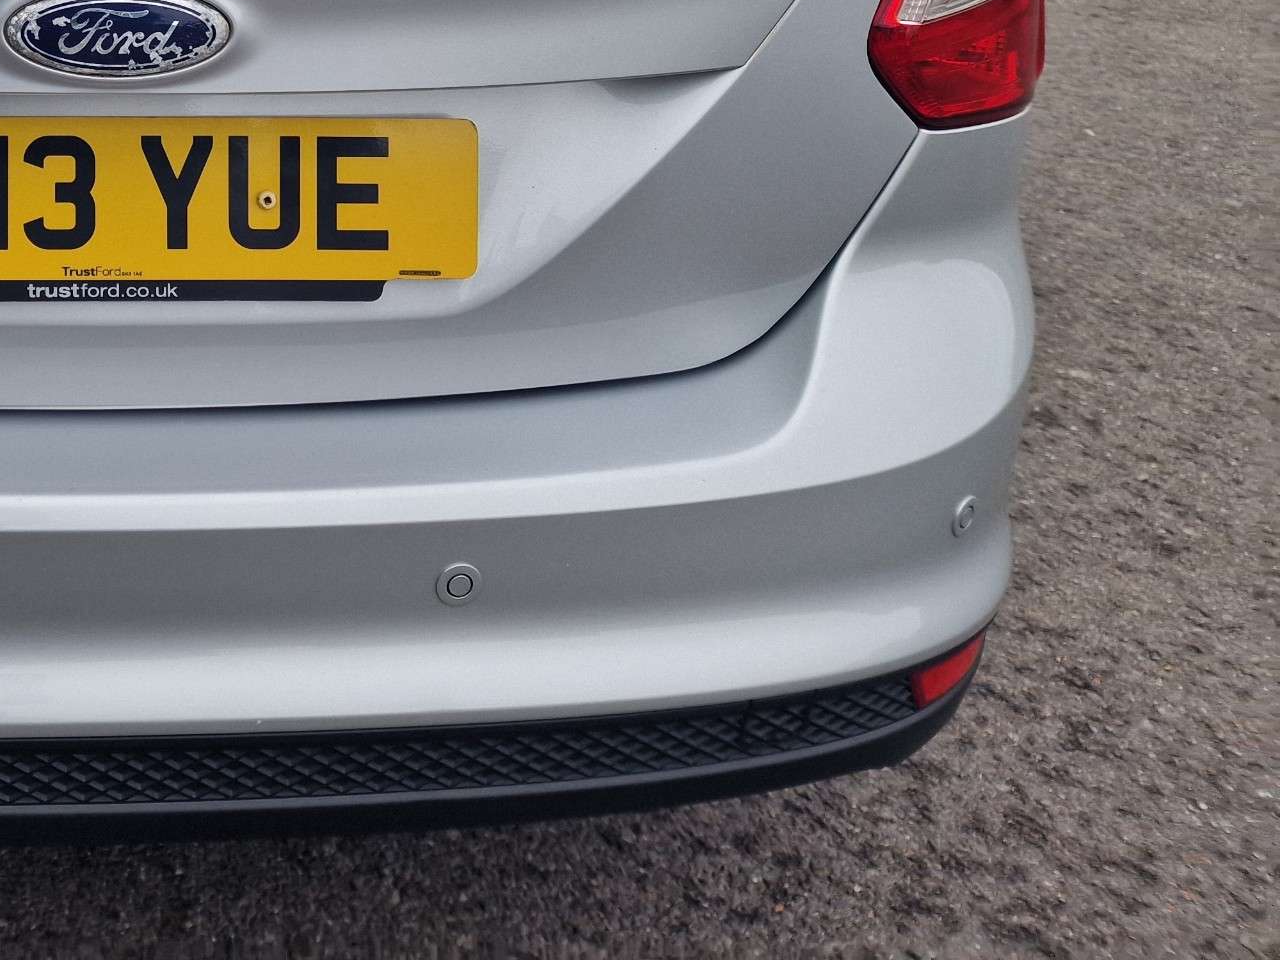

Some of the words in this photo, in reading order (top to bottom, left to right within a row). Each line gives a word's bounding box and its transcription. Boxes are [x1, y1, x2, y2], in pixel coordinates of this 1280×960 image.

[58, 8, 182, 55] Ford
[140, 135, 389, 251] YUE
[61, 266, 121, 277] TrustFord
[26, 283, 179, 298] trustford.co.uk
